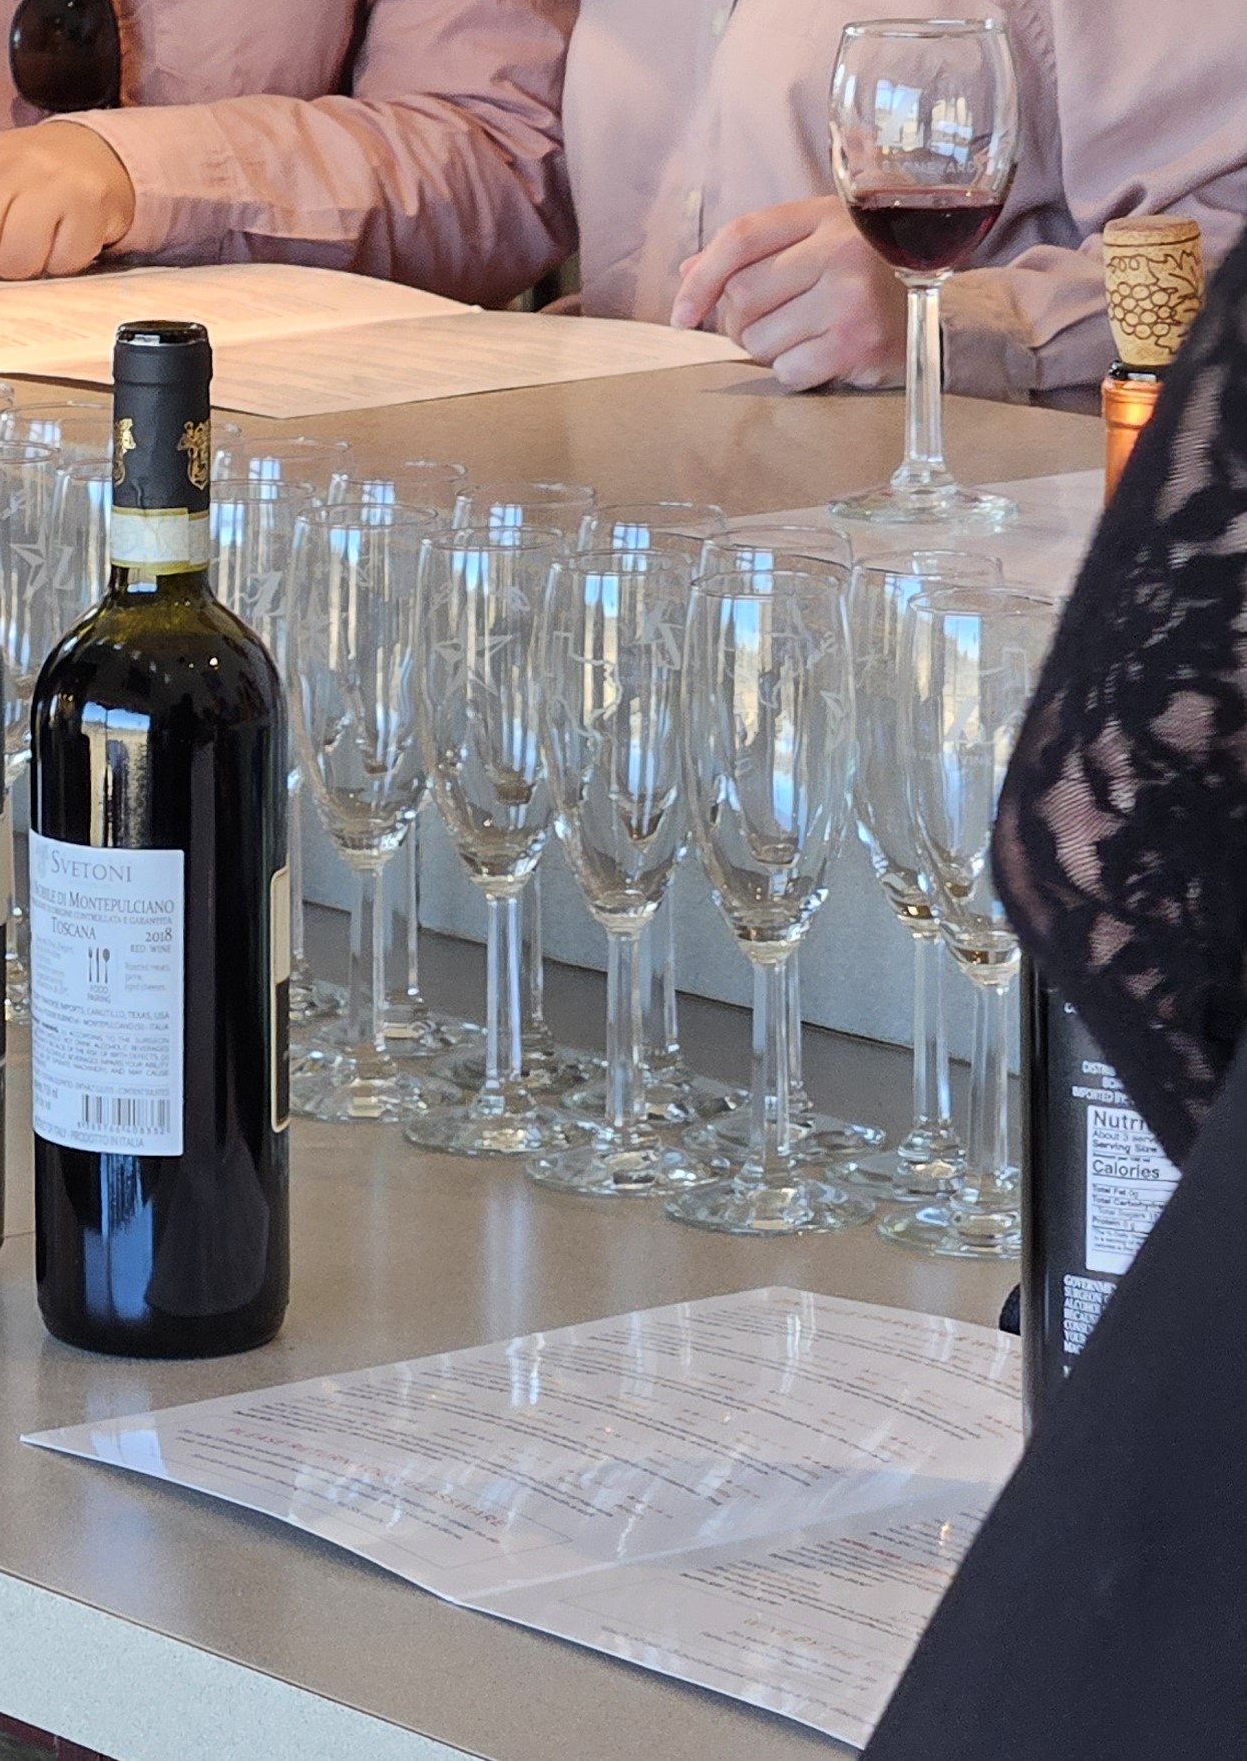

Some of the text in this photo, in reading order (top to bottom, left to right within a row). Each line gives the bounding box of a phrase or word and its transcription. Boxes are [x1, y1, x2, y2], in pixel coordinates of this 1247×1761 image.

[69, 891, 175, 914] MONTEPULCIANO
[51, 916, 173, 943] TOSCANA 2018
[1093, 1139, 1131, 1154] Serving
[1093, 1159, 1159, 1179] Calories
